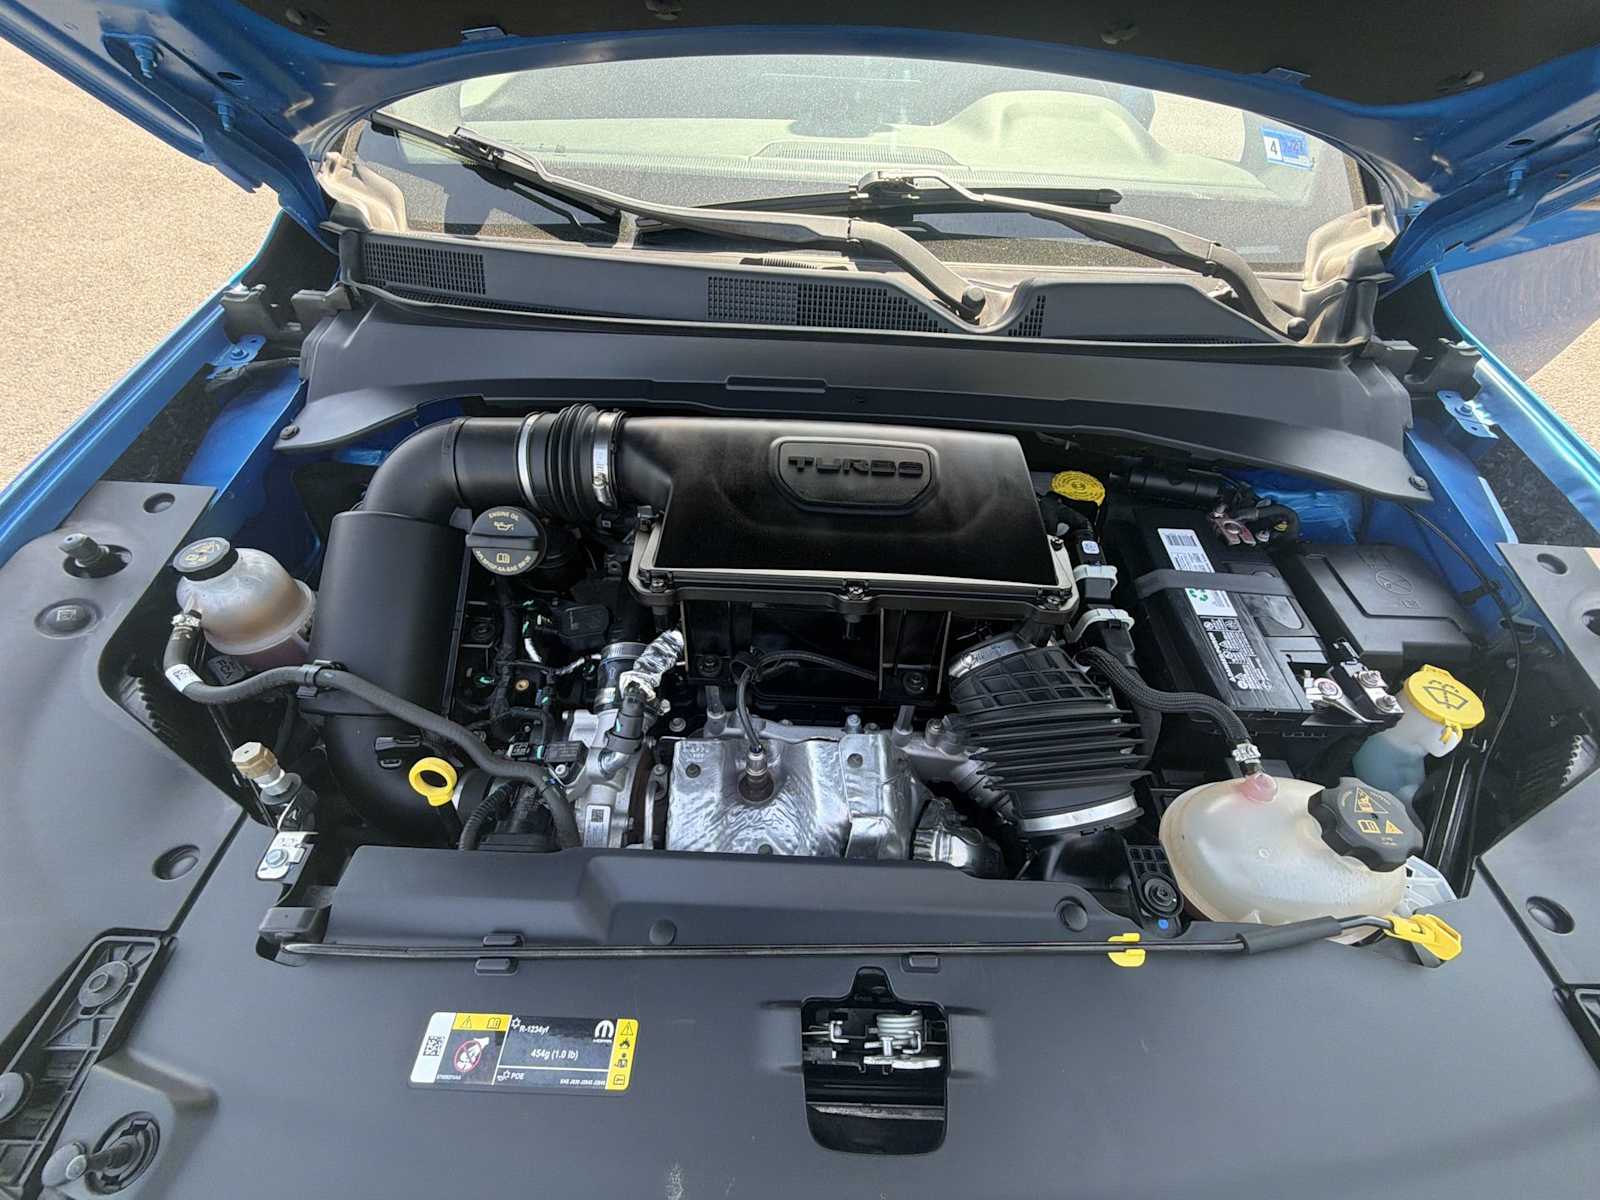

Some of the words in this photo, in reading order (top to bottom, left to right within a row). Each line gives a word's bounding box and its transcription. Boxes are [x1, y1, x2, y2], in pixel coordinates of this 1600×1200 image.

[1270, 140, 1278, 155] 4
[788, 456, 923, 477] TURBO
[488, 511, 510, 519] ENGINE
[510, 513, 519, 521] OIL
[519, 1025, 550, 1035] R-1234yf
[530, 1048, 550, 1060] 454g
[551, 1049, 567, 1060] (1.0
[567, 1050, 579, 1061] lb)
[510, 1072, 525, 1080] POE
